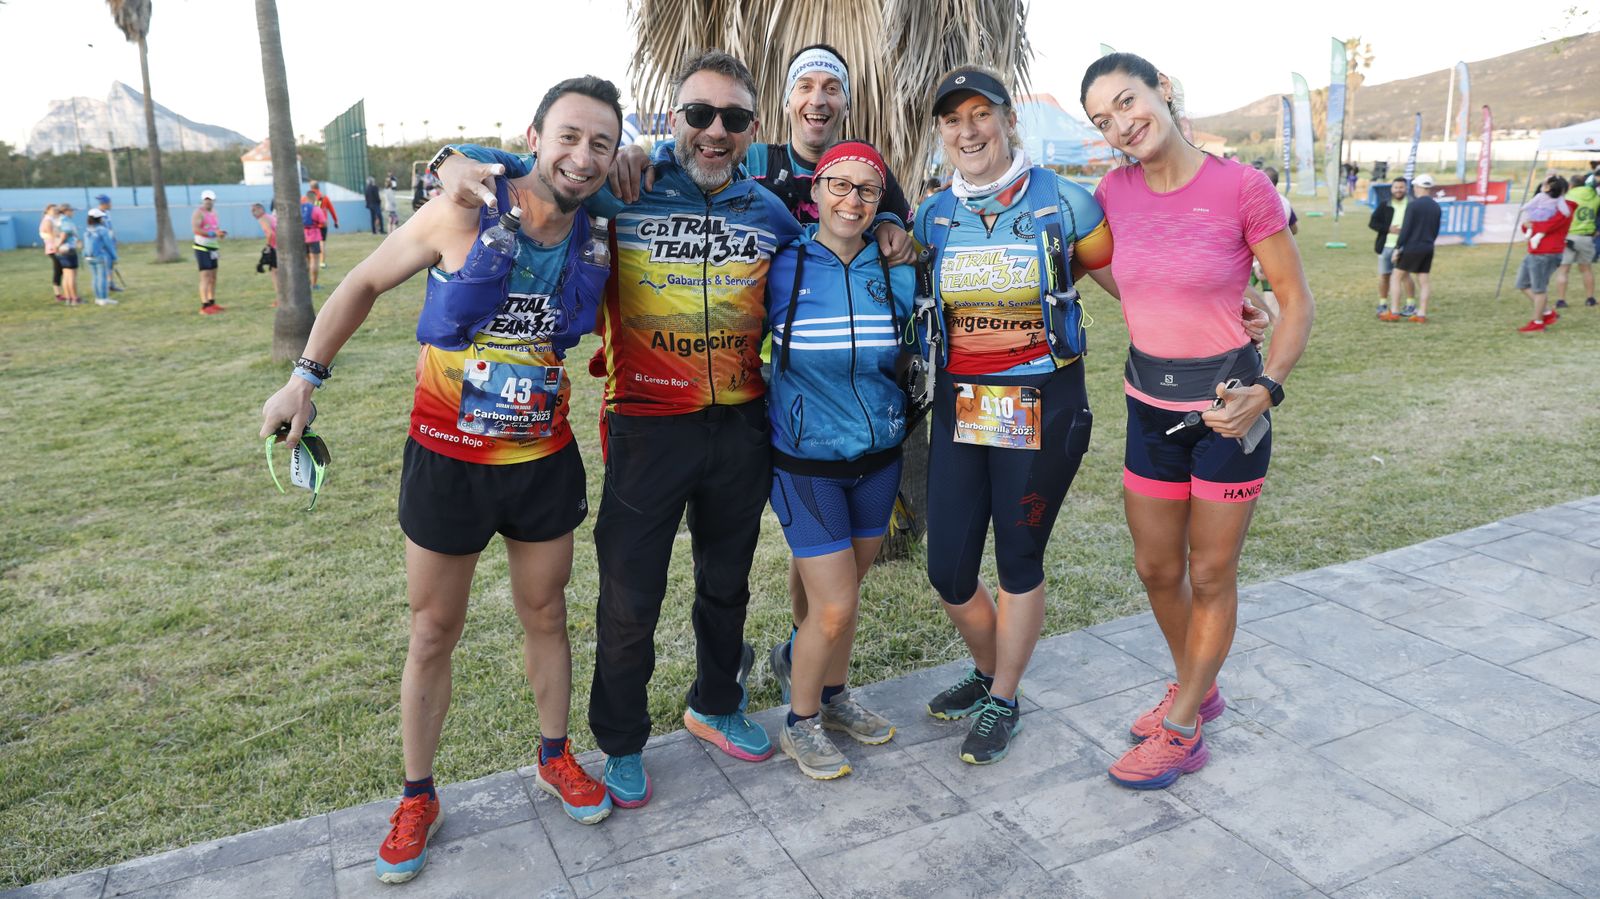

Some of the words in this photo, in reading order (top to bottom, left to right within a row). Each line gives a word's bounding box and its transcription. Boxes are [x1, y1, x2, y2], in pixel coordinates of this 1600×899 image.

[792, 61, 840, 80] NINGUNO
[671, 217, 725, 237] TRAIL
[654, 240, 713, 259] TEAM
[956, 251, 1003, 271] TRAIL
[944, 271, 989, 288] TEAM
[651, 330, 749, 357] Algeciras
[635, 373, 643, 381] El
[644, 376, 669, 386] Cerezo
[671, 378, 689, 388] Rojo
[500, 377, 533, 404] 43
[473, 408, 529, 422] Carbonera
[531, 412, 551, 422] 2023
[980, 395, 1015, 419] 410
[420, 424, 428, 435] El
[428, 428, 460, 443] Cerezo
[462, 435, 483, 448] Rojo
[958, 420, 1010, 434] Carbonerilla
